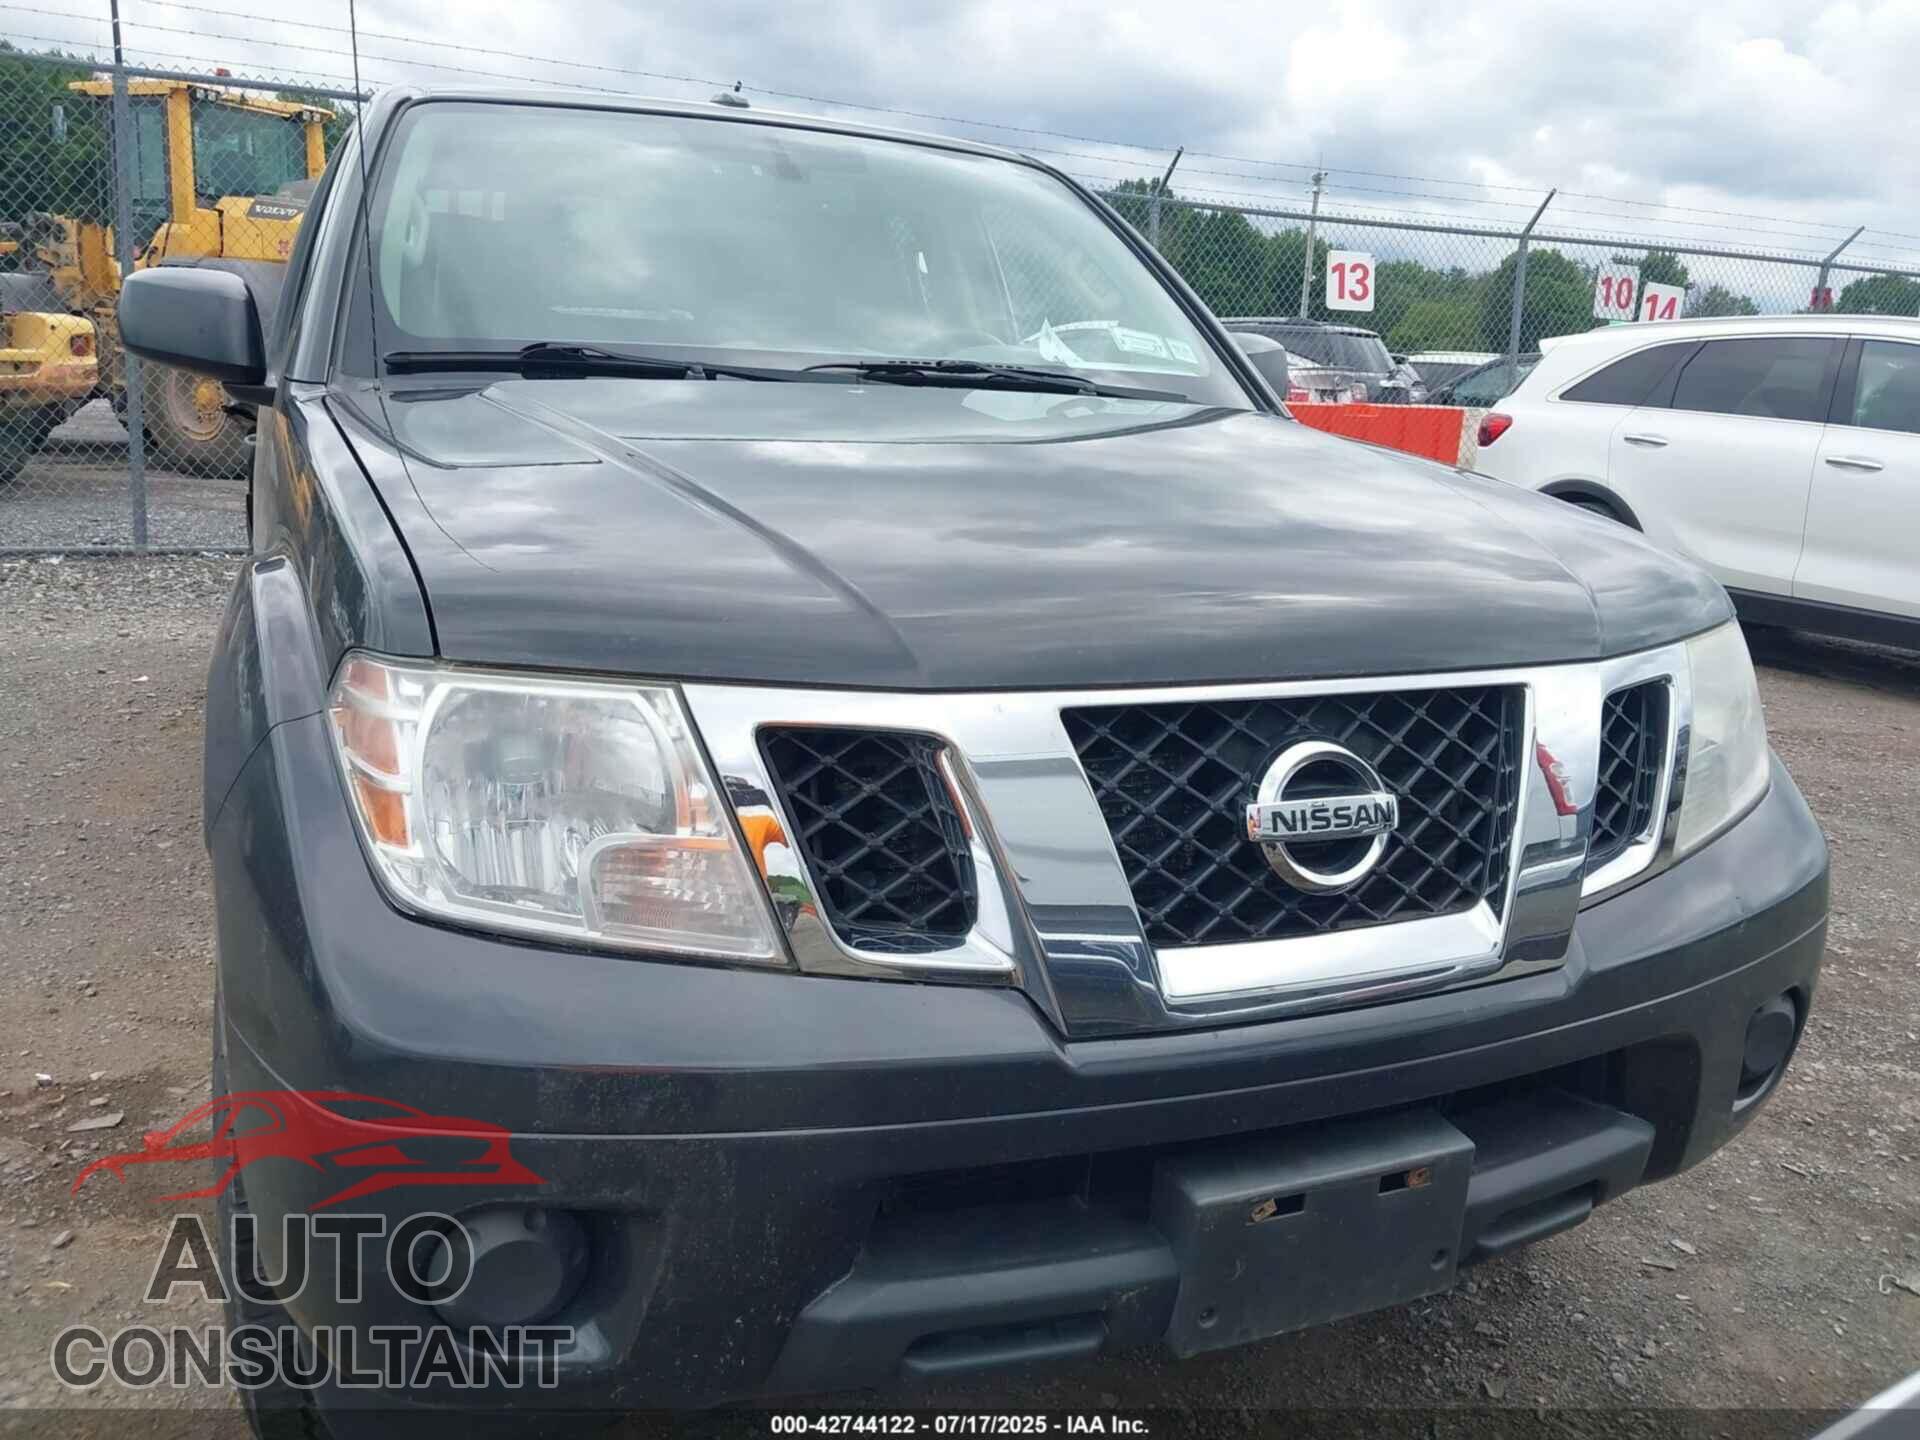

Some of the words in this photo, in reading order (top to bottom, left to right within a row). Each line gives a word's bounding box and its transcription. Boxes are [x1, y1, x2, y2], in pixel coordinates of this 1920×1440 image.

[255, 205, 299, 217] VOLVO
[1331, 262, 1369, 301] 13
[1601, 276, 1633, 310] 10
[1646, 294, 1677, 320] 14
[1270, 801, 1393, 833] NISSAN
